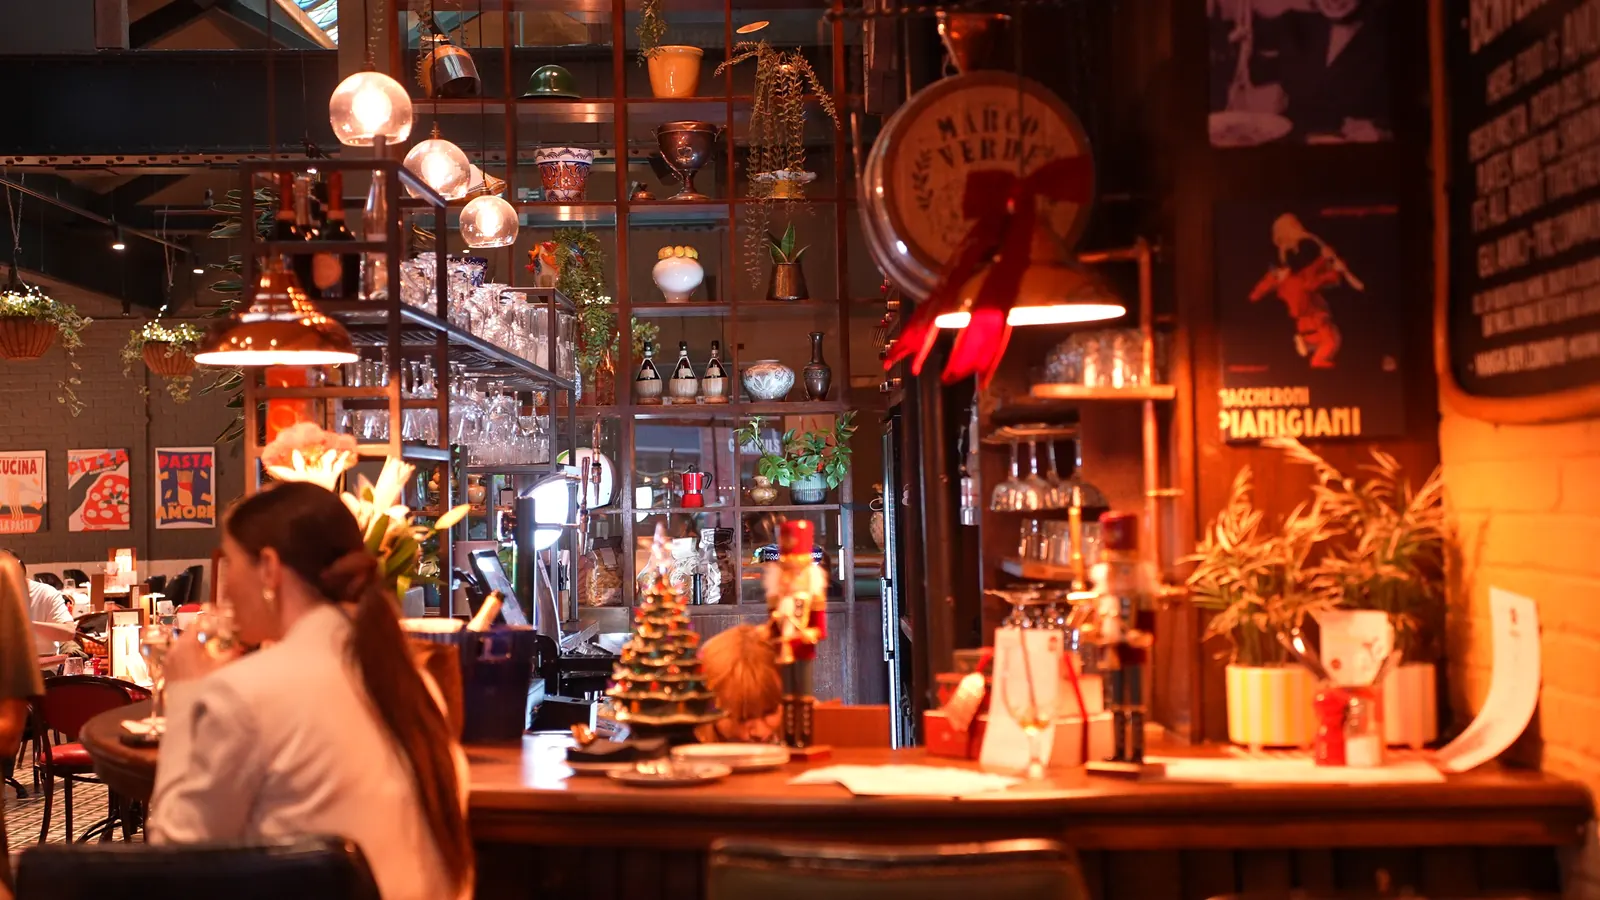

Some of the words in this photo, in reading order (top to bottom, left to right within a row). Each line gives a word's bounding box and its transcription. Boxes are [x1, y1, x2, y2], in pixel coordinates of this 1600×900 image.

[937, 109, 1039, 140] MARCO
[0, 459, 37, 475] UCINA
[68, 449, 129, 475] PIZZA
[158, 453, 212, 469] PASTA
[157, 504, 215, 519] AMORE
